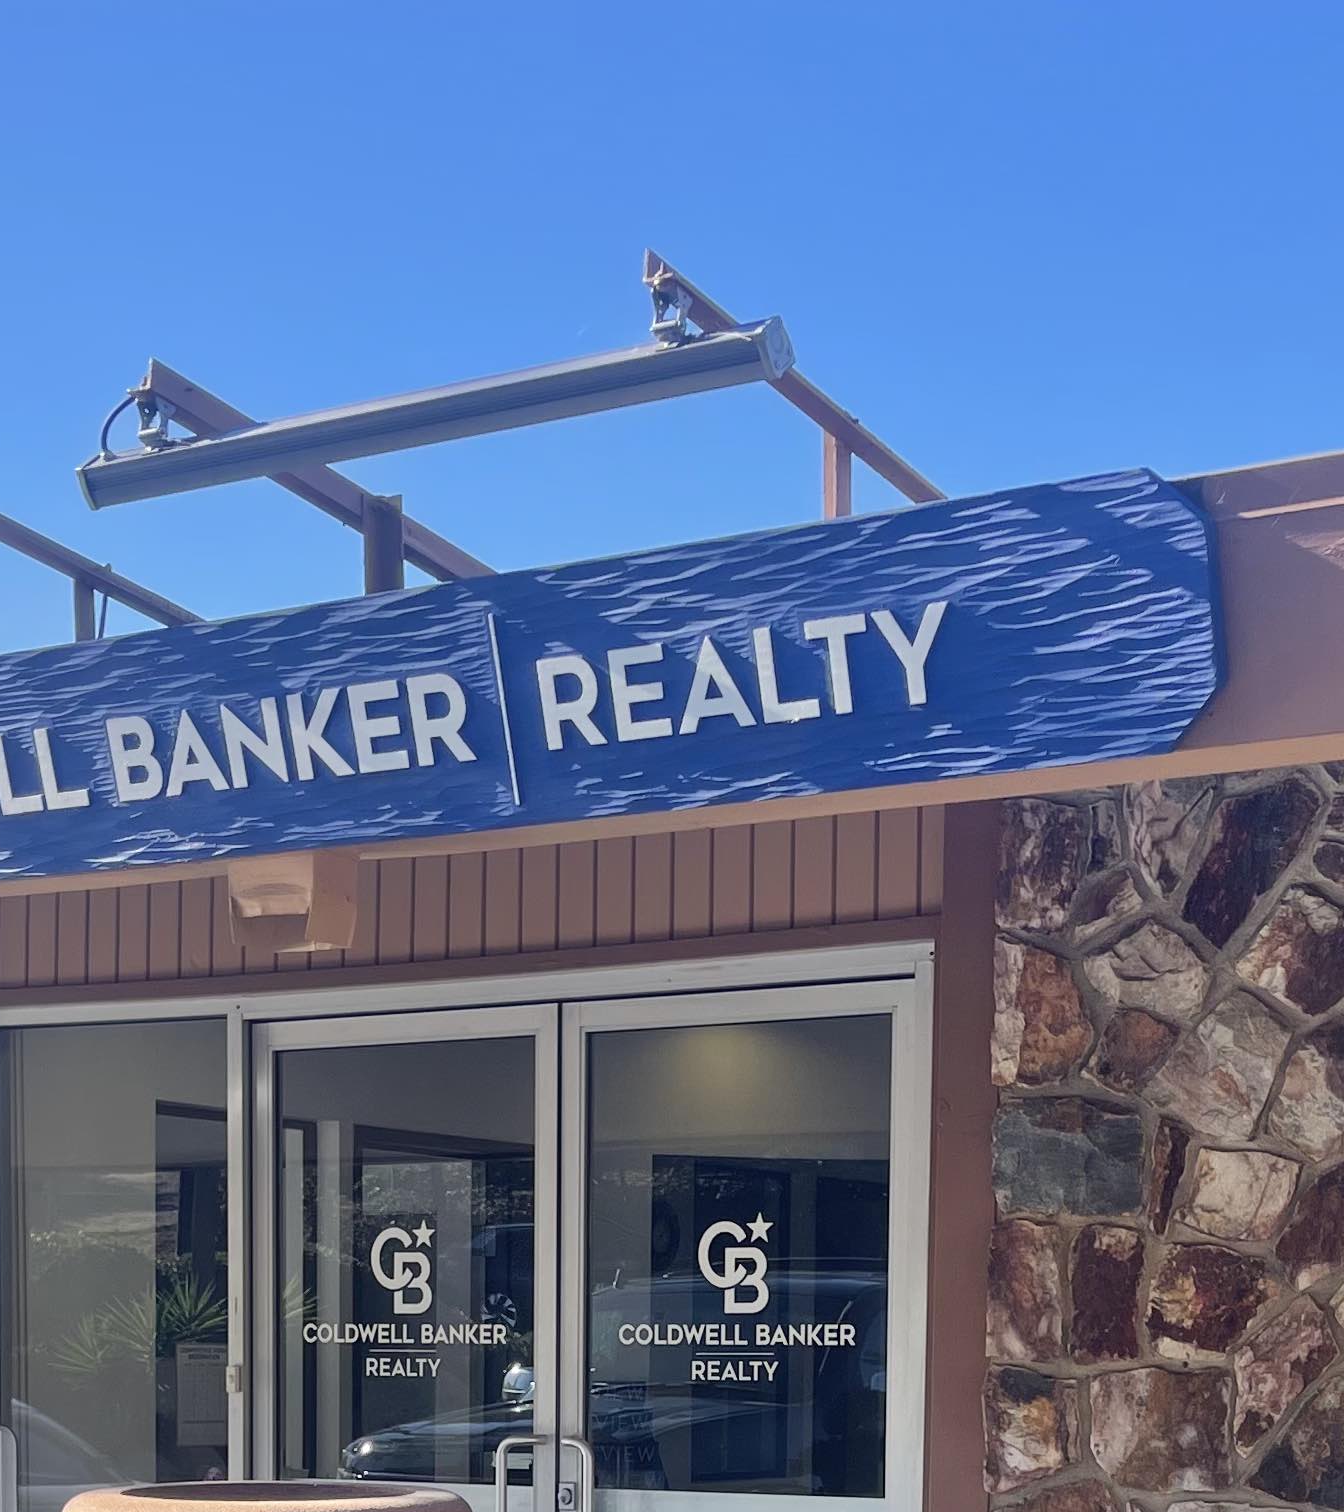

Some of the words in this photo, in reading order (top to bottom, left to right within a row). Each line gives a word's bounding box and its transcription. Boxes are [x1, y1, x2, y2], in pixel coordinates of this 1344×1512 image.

[103, 672, 477, 804] BANKER
[535, 599, 950, 753] REALTY
[302, 1322, 415, 1345] COLDWELL
[420, 1323, 507, 1345] BANKER
[618, 1323, 748, 1346] COLDWELL
[755, 1323, 856, 1347] BANKER
[365, 1357, 441, 1378] REALTY
[690, 1360, 779, 1382] REALTY
